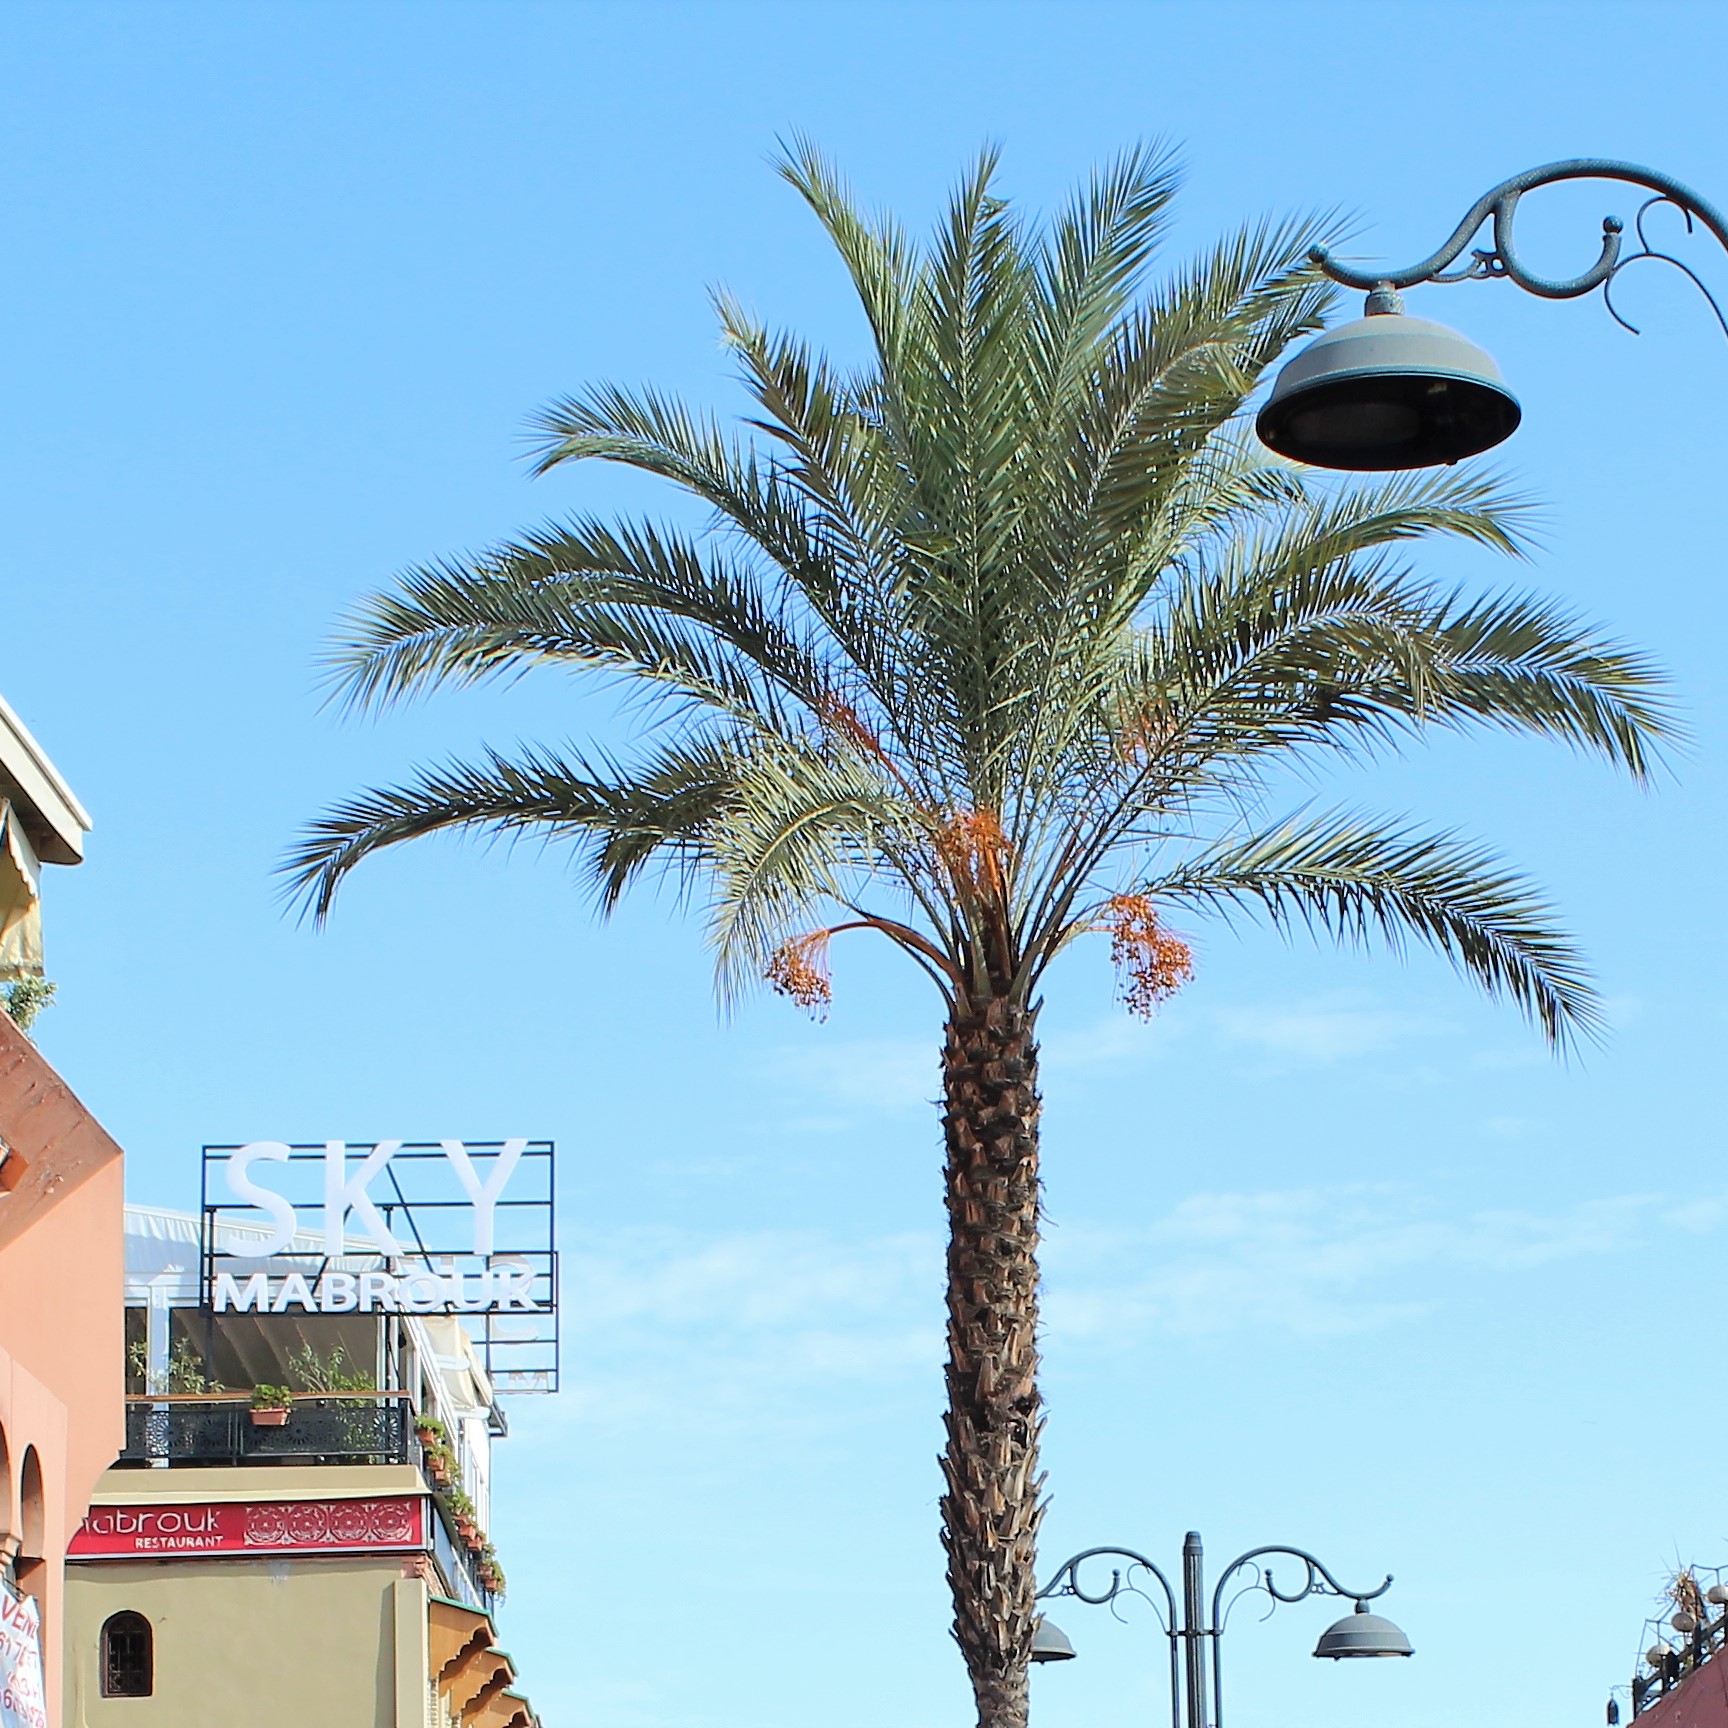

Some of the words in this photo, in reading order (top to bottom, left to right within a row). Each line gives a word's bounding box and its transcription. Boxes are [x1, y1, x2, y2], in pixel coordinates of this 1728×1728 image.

[224, 1139, 529, 1257] SKY
[213, 1271, 541, 1313] MABROUK
[135, 1535, 224, 1549] RESTAURANT
